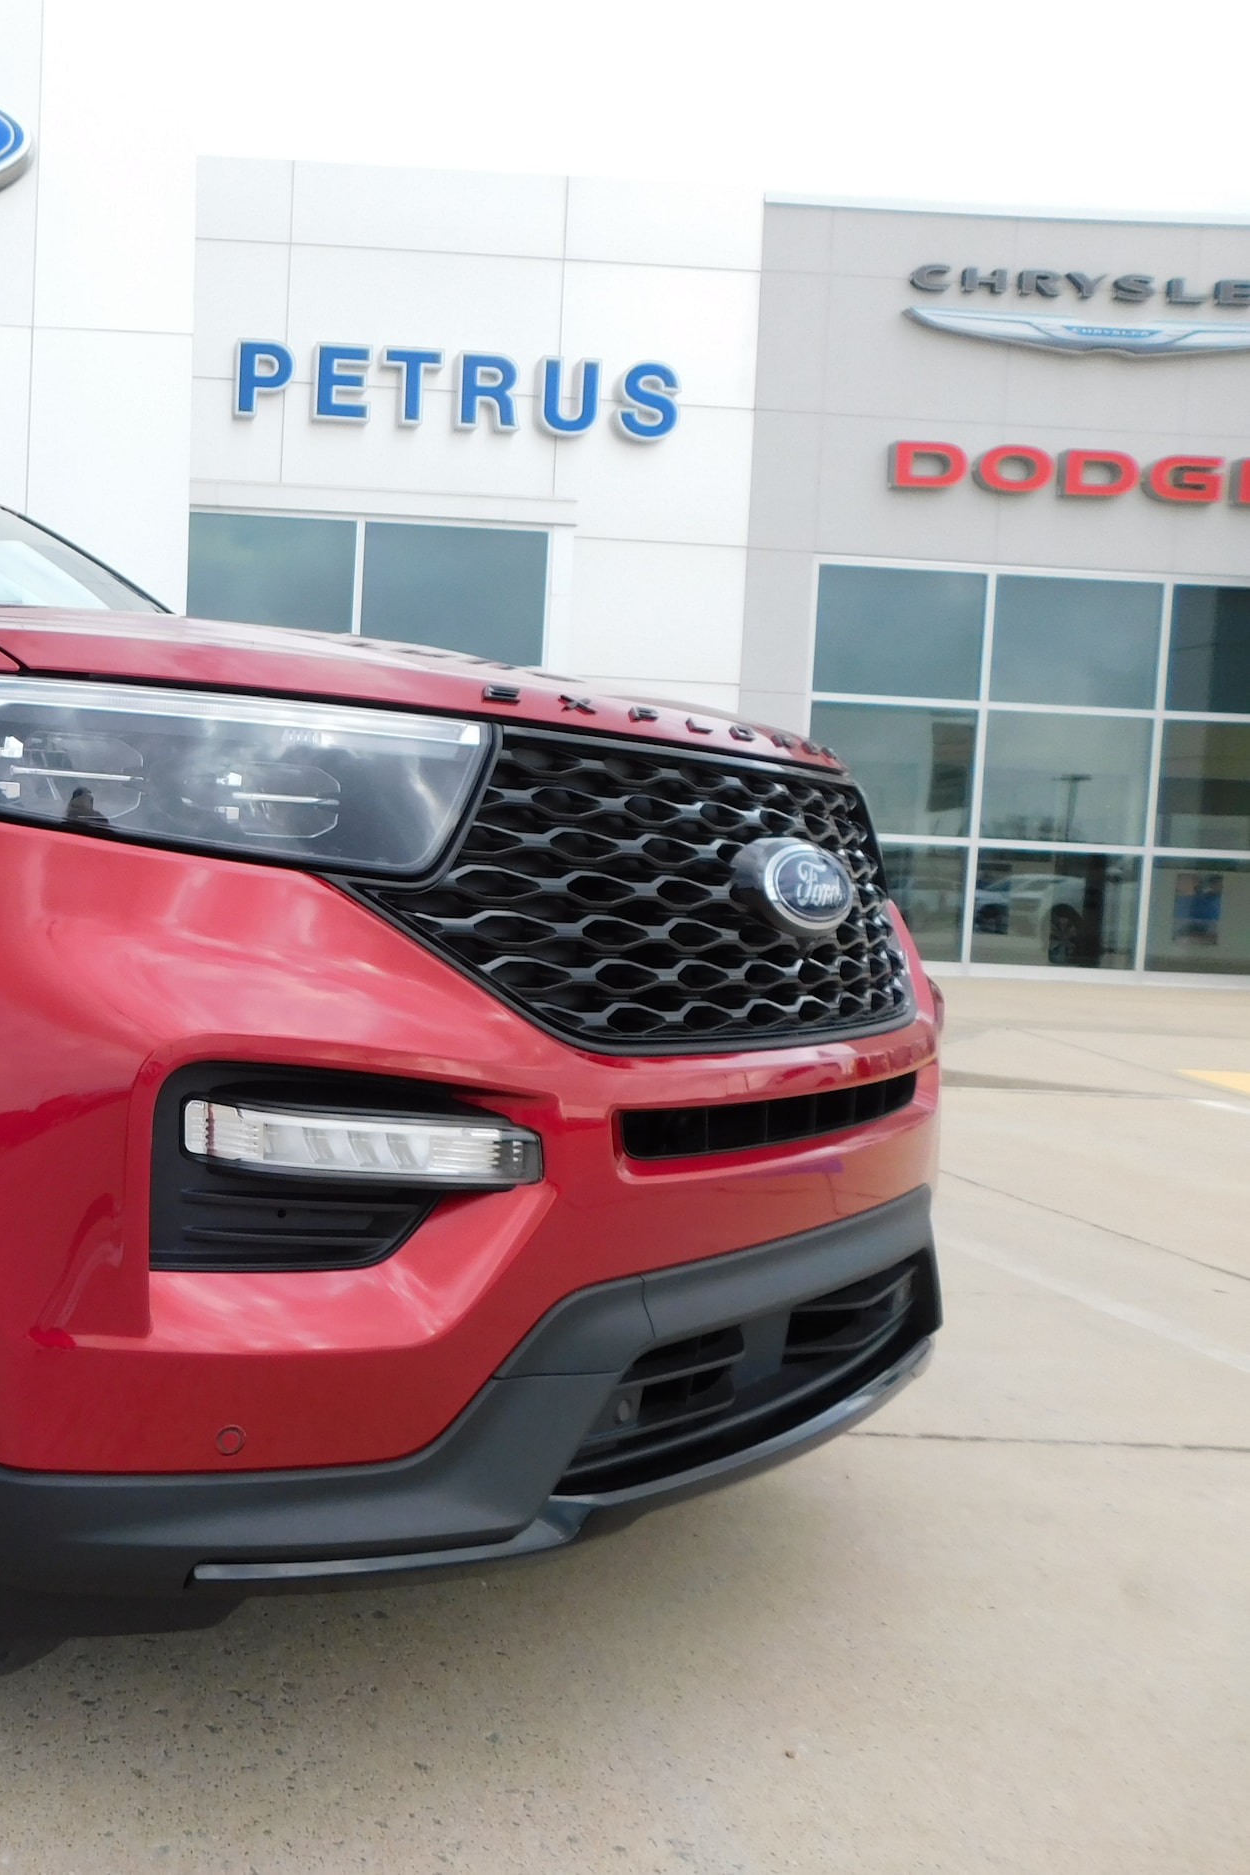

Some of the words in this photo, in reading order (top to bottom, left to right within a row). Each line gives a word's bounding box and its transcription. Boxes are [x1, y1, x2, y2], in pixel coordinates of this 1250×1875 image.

[233, 338, 682, 443] PETRUS
[888, 440, 1250, 507] DODG
[796, 860, 844, 908] Ford
